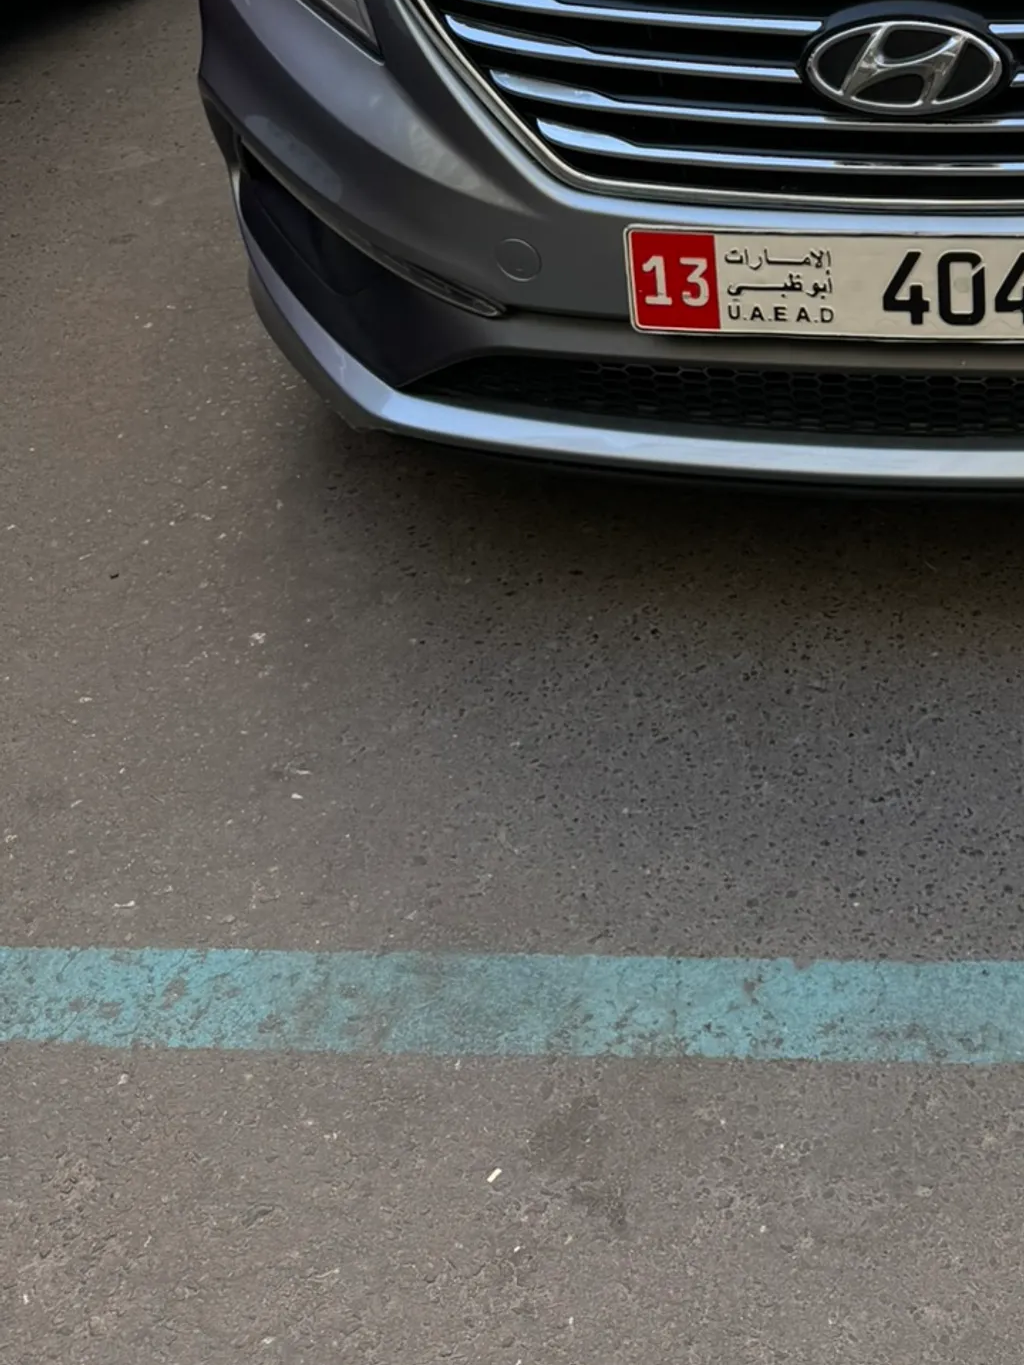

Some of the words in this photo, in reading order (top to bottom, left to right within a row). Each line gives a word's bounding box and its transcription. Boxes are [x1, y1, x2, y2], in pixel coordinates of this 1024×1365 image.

[642, 255, 710, 307] 13
[728, 305, 788, 322] U.A.E
[796, 307, 835, 323] A.D
